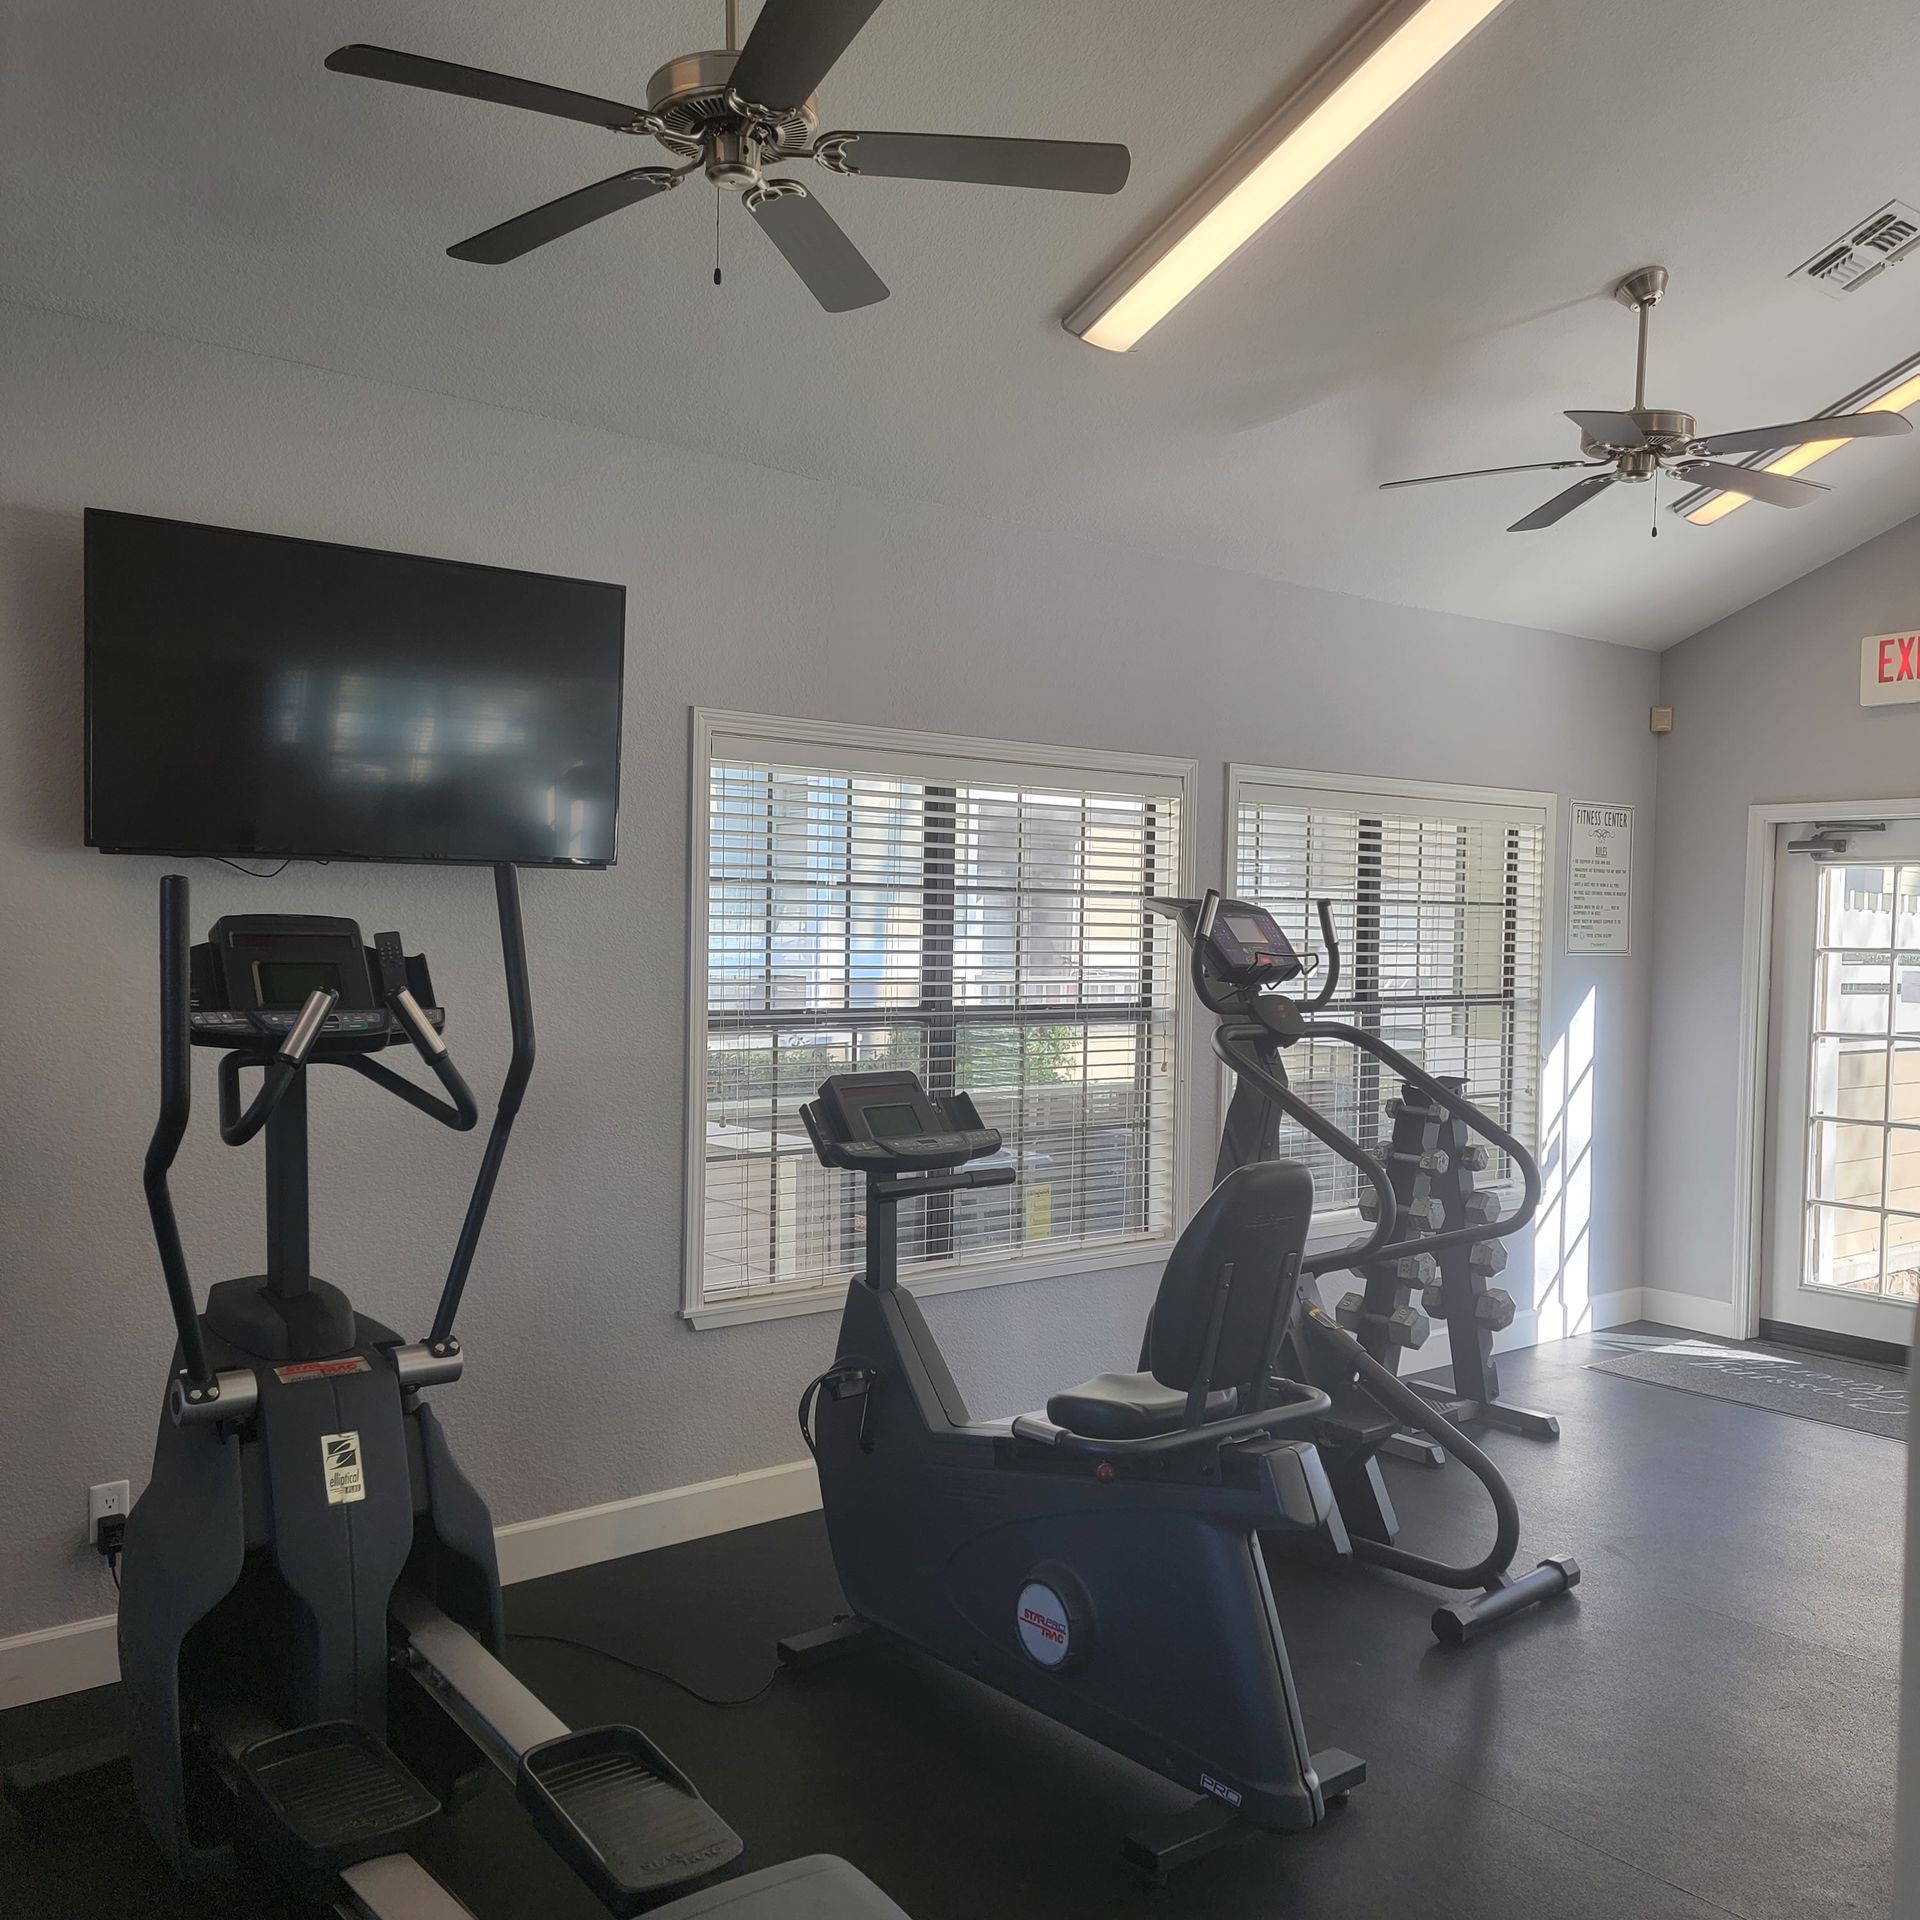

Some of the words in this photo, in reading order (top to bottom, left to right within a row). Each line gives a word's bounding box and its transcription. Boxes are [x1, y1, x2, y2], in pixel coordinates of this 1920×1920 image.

[1576, 809, 1601, 826] FITNESS
[1604, 811, 1628, 828] CENTER
[329, 1468, 360, 1488] elliptical
[1023, 1608, 1045, 1625] STAR
[1040, 1628, 1064, 1645] TRAC
[1201, 1774, 1241, 1806] PRO
